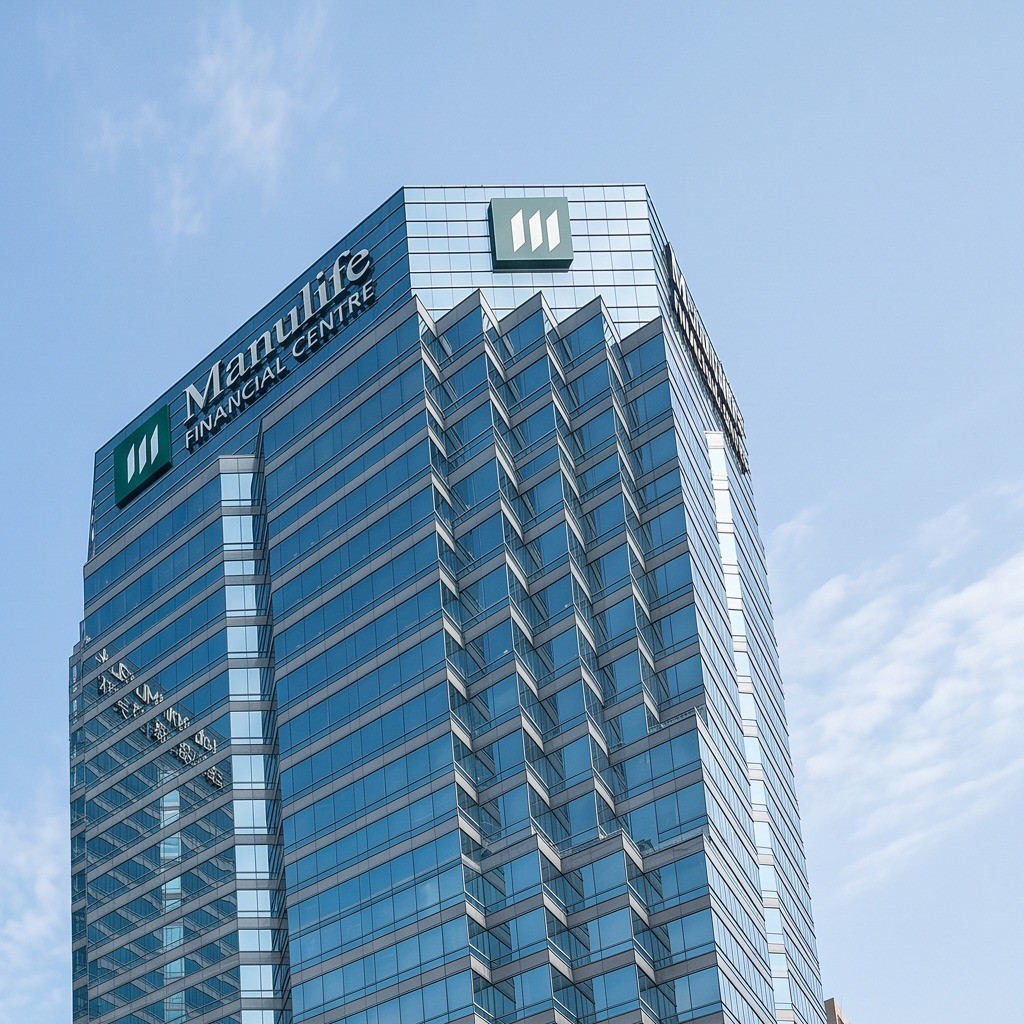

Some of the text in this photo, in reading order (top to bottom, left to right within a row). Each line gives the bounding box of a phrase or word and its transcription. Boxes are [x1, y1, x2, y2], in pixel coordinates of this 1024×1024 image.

[184, 249, 371, 425] Manulife
[185, 279, 374, 449] FINANCIAL CENTRE
